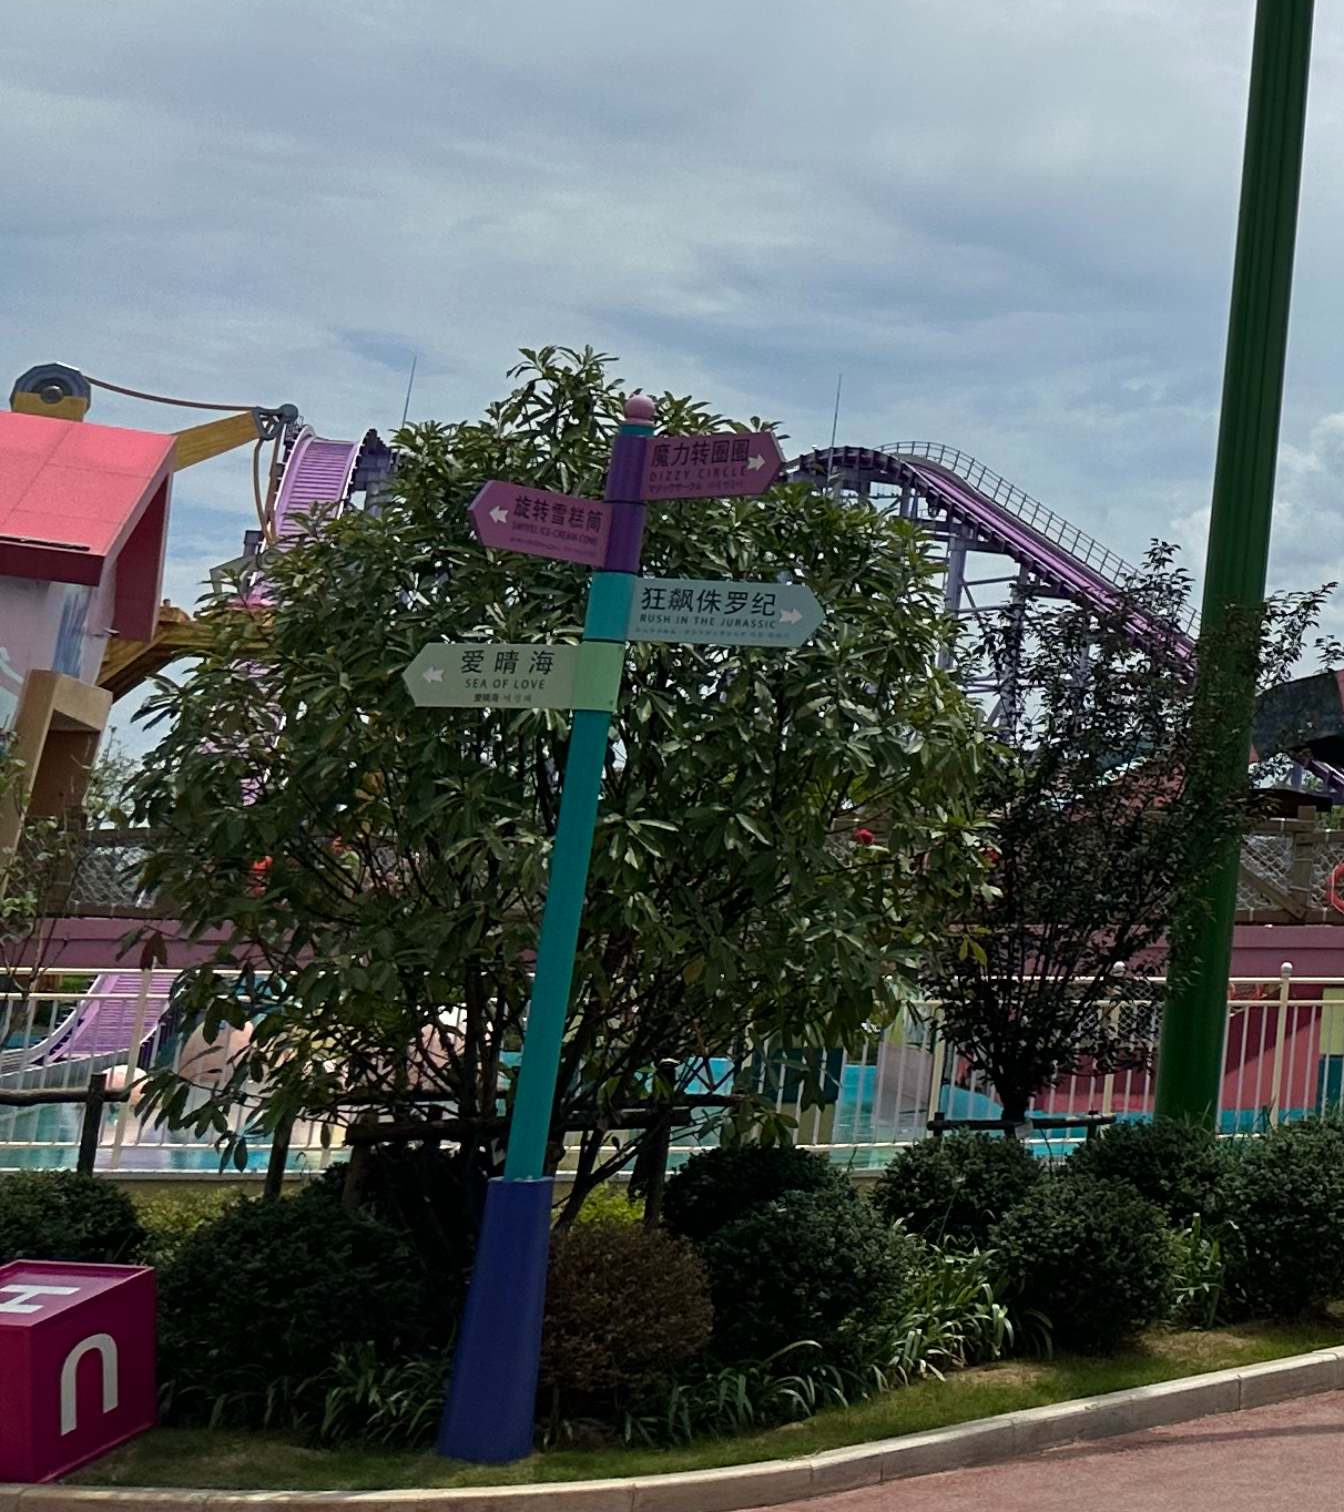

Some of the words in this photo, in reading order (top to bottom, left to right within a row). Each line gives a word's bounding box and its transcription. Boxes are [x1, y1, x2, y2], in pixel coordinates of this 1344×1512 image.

[651, 439, 750, 468] 魔力转圈圈
[649, 470, 690, 482] DIZZY
[698, 465, 747, 479] CIRCLE
[513, 495, 603, 534] 旋转雪糕筒
[641, 587, 777, 617] 狂飙侏罗纪
[639, 613, 671, 624] RUSH
[676, 615, 689, 624] IN
[694, 616, 715, 626] THE
[720, 618, 777, 630] JURASSIC
[461, 649, 555, 675] 爱晴海
[465, 678, 487, 689] SEA
[492, 678, 509, 689] OF
[514, 679, 546, 689] LOVE
